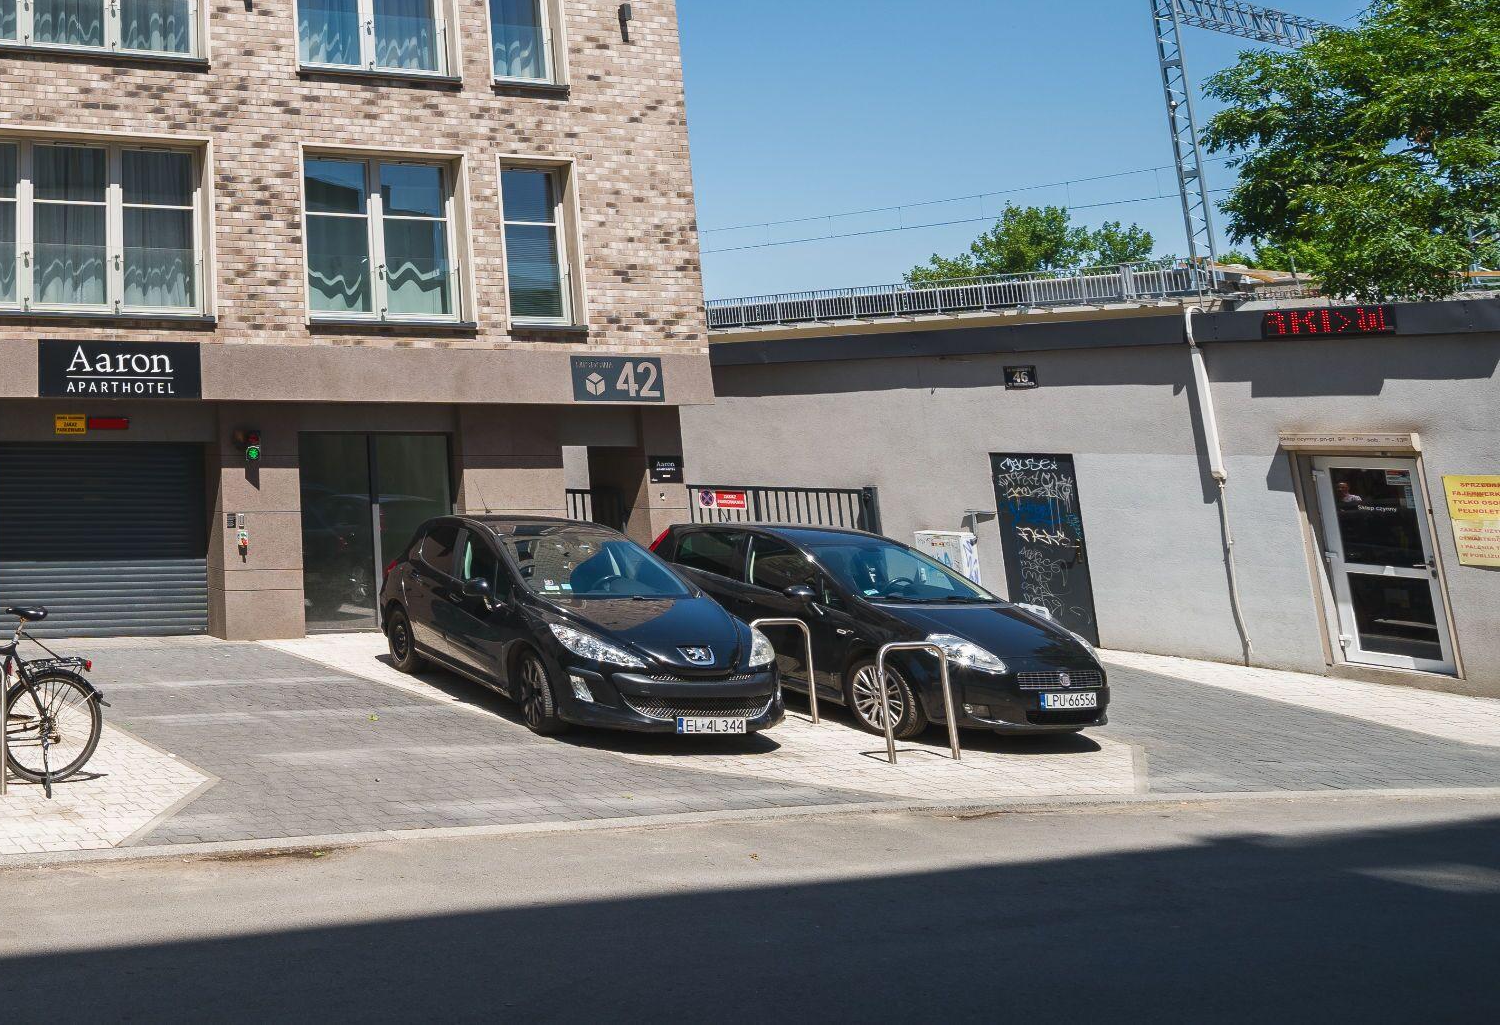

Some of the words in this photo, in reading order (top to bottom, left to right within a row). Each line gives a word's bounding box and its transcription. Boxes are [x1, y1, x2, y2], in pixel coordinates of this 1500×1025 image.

[66, 344, 174, 374] Aaron
[616, 361, 661, 397] 42
[1012, 371, 1029, 383] 46
[66, 381, 175, 394] APARTHOTEL
[1046, 694, 1066, 707] LPU
[1068, 693, 1095, 706] 66556
[686, 719, 702, 732] EL
[706, 719, 744, 733] 4L344
